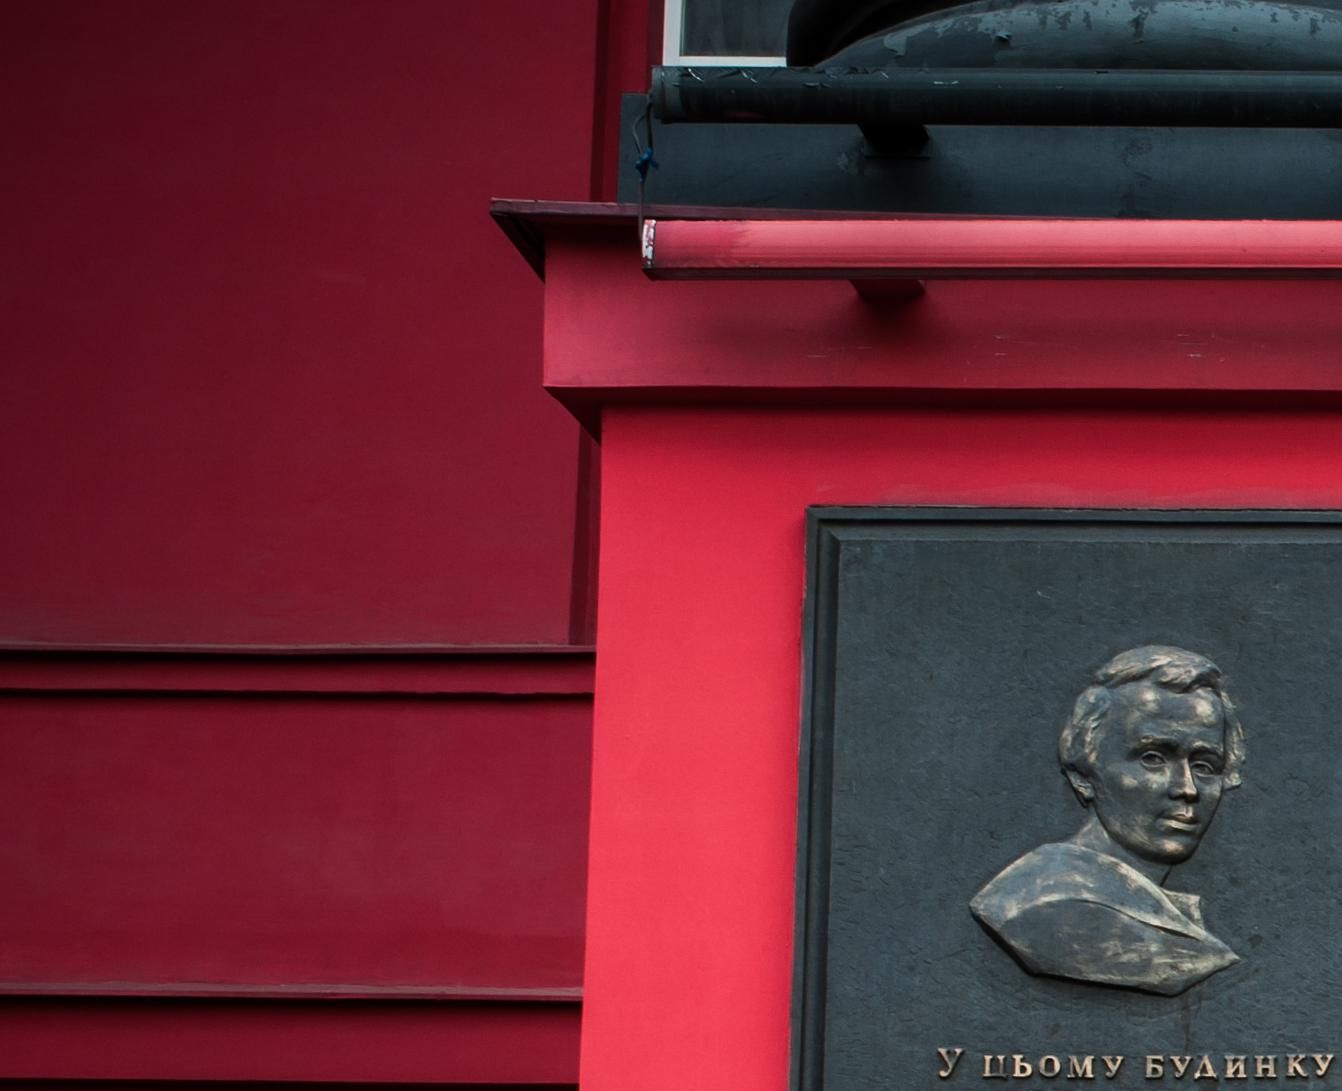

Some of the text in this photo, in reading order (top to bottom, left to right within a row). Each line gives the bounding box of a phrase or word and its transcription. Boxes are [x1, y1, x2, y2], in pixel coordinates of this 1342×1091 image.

[939, 1048, 1334, 1080] У ЦЬОМУ БУДИНКУ
